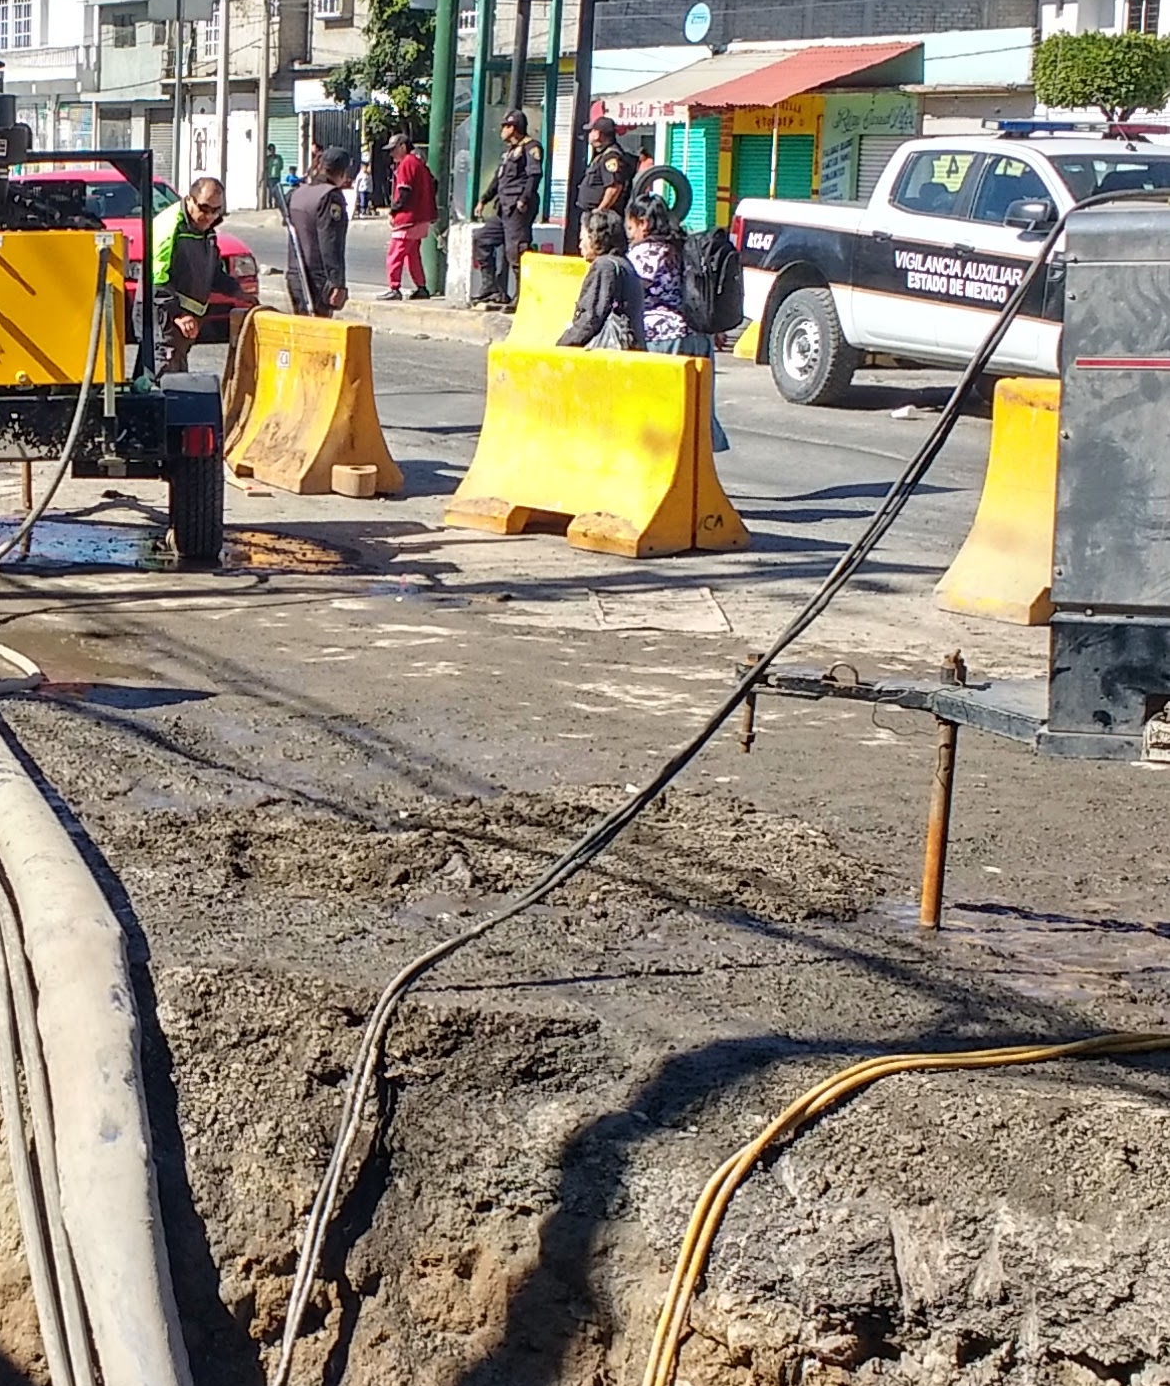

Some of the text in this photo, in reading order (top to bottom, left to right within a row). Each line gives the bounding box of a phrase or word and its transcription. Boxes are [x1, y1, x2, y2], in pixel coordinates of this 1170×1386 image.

[894, 250, 1024, 286] VIGILANCIA AUXILIAR
[907, 271, 1008, 304] ESTADO DE MEXICO
